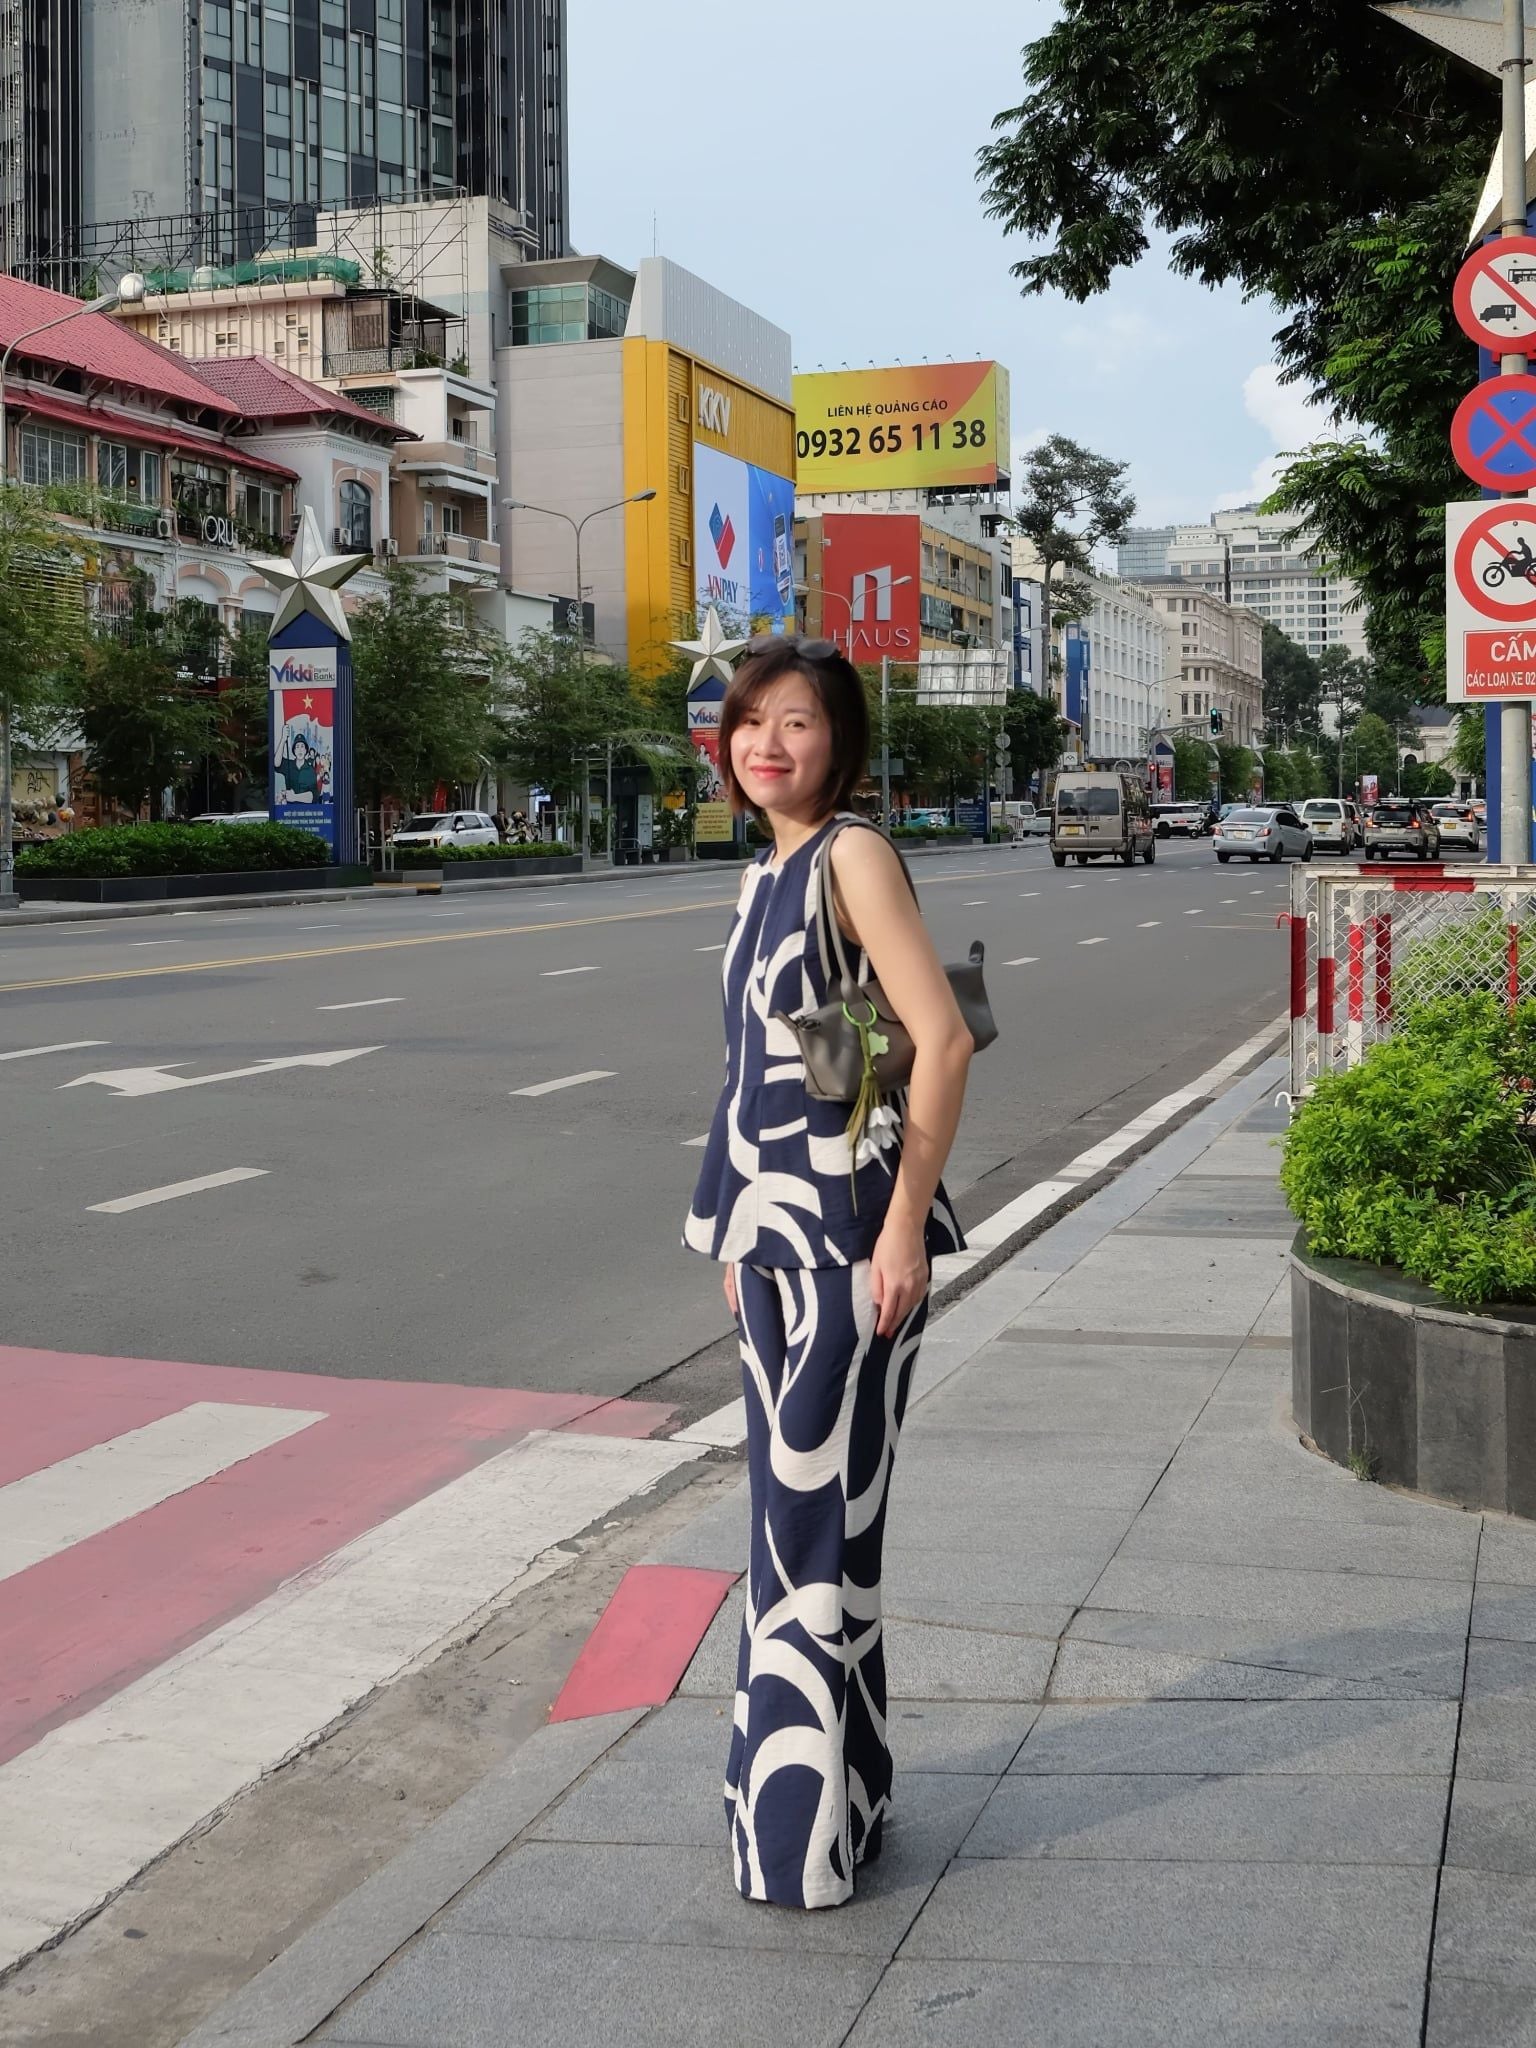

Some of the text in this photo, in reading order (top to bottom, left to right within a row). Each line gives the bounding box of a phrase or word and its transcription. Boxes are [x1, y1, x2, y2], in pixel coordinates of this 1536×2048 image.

[699, 384, 730, 437] KKV
[828, 398, 948, 418] LIÊN HỆ QUẢNG CÁO
[797, 419, 986, 458] 0932 65 11 38
[200, 513, 233, 545] YORU
[708, 574, 737, 603] VNPAY
[271, 656, 314, 683] Vikki
[314, 672, 334, 681] Bank
[1467, 669, 1485, 687] CÁC
[1488, 672, 1508, 689] LOẠI
[1511, 672, 1523, 686] XE
